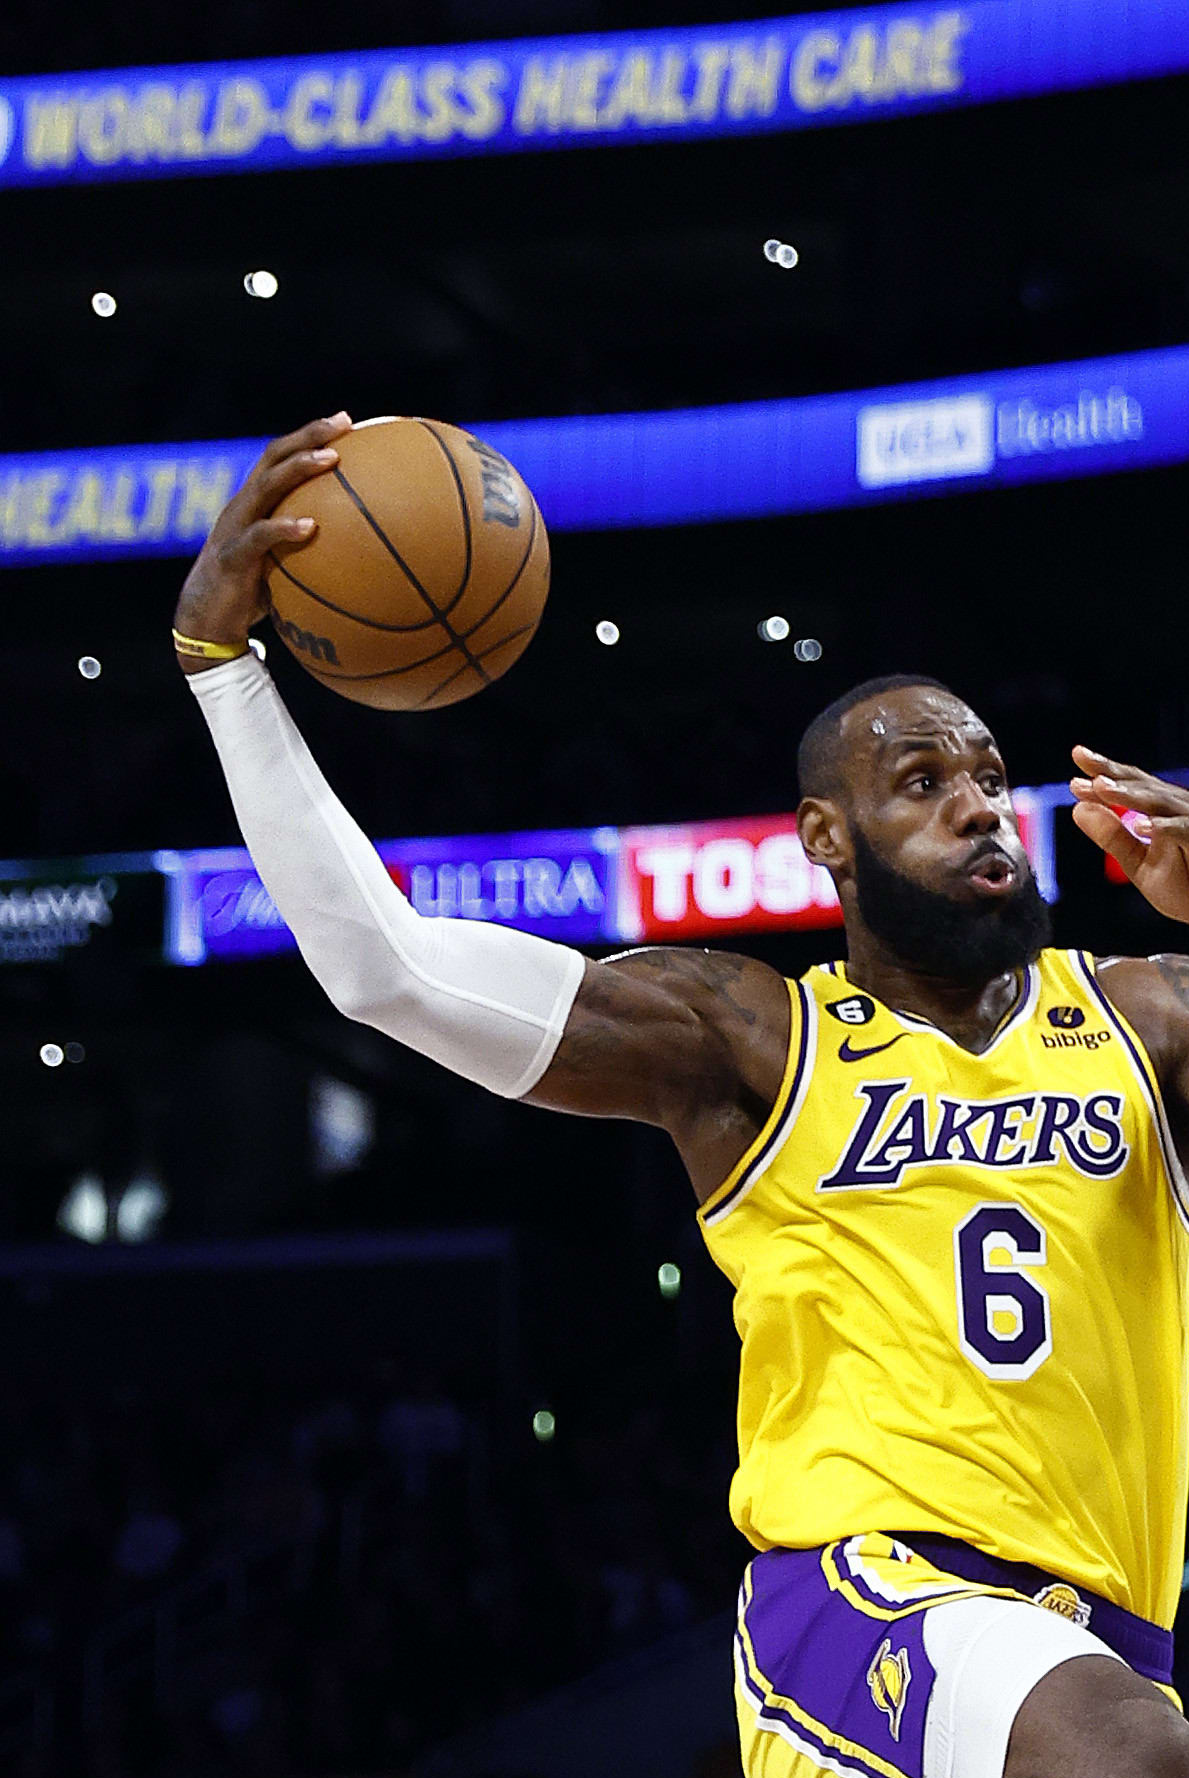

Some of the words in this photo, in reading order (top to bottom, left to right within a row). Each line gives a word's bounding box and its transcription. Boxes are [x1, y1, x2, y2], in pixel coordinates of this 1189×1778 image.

[24, 62, 503, 169] WORLD-CLASS
[514, 38, 782, 135] HEALTH
[791, 12, 966, 111] CARE
[408, 858, 604, 920] ULTRA
[1040, 1030, 1112, 1050] bibigo
[817, 1078, 1130, 1192] LAKERS
[954, 1203, 1052, 1380] 6
